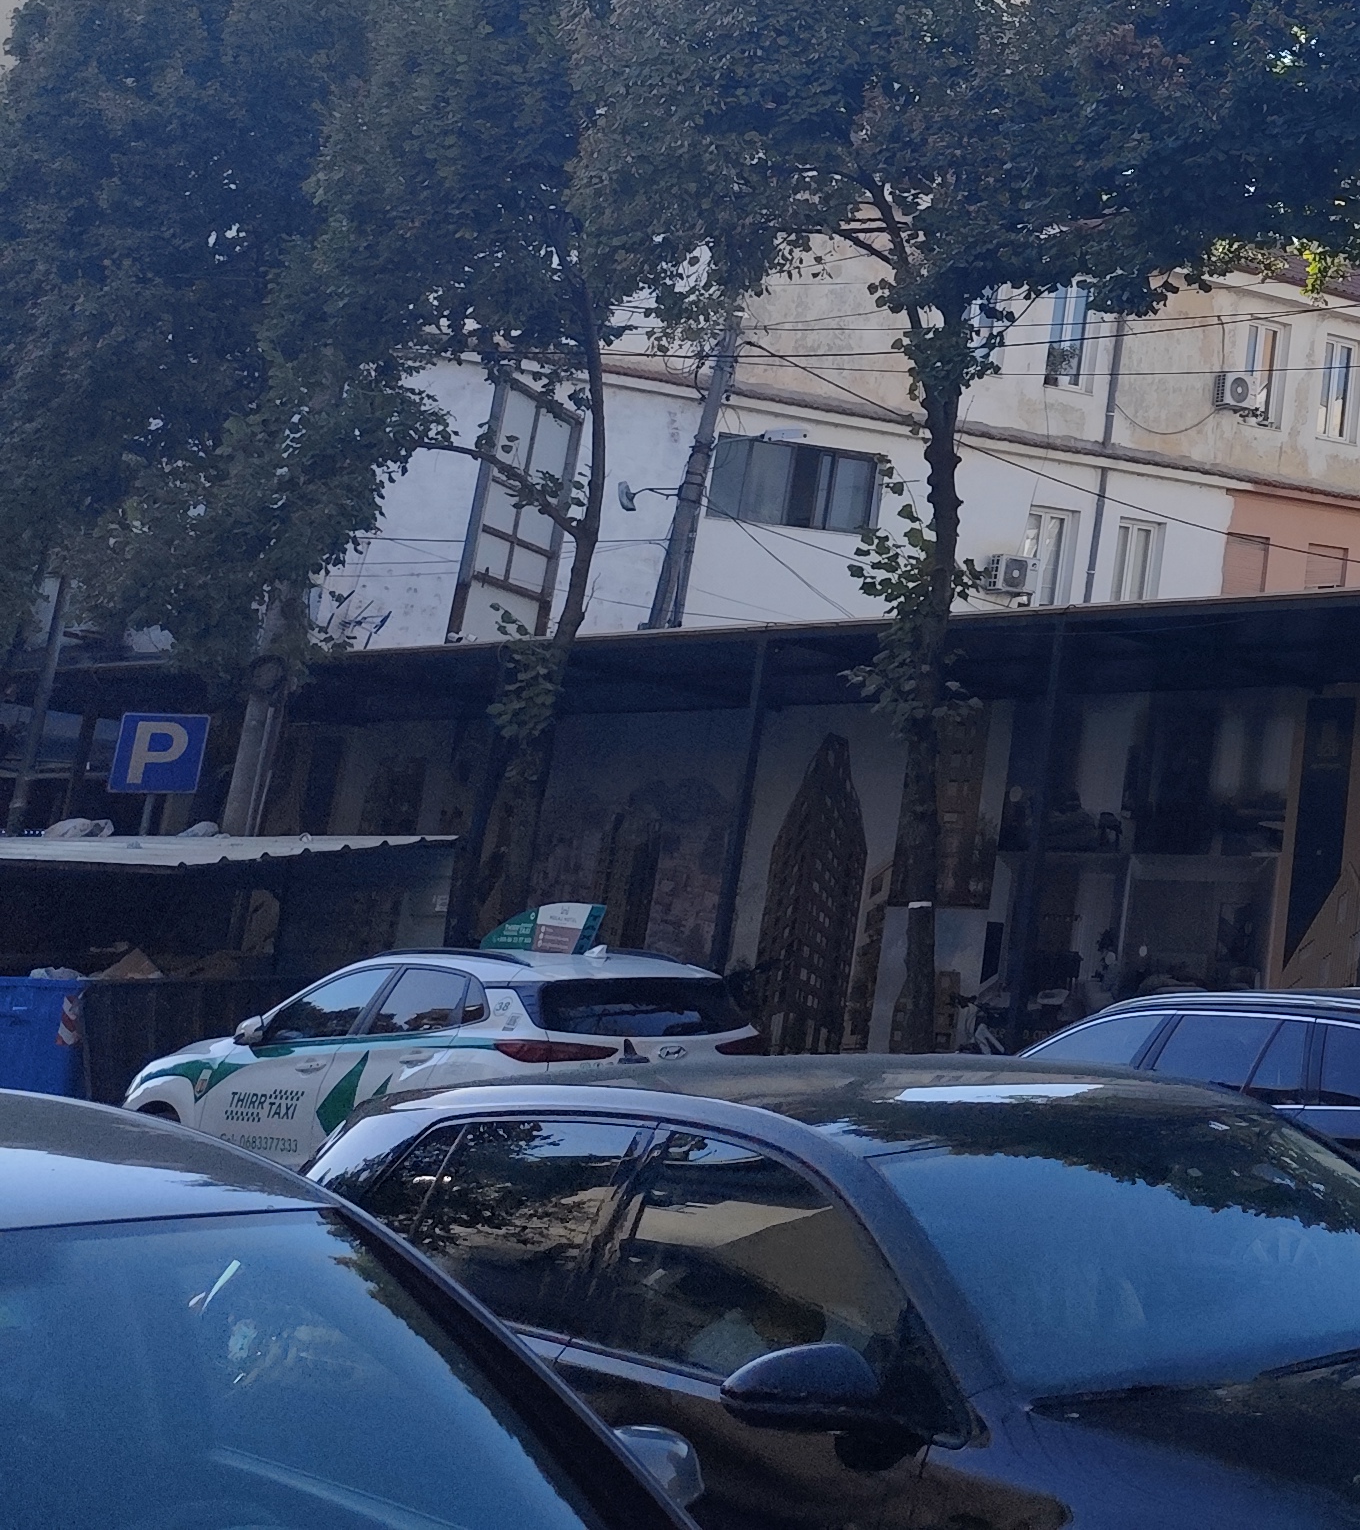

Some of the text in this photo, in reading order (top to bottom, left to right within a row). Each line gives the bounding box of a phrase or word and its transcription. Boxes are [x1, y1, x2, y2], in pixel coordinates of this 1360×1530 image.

[126, 721, 188, 784] P
[496, 1001, 511, 1012] 38
[229, 1091, 267, 1110] THIRR
[266, 1101, 298, 1120] TAXI
[240, 1134, 298, 1153] 0683377333
